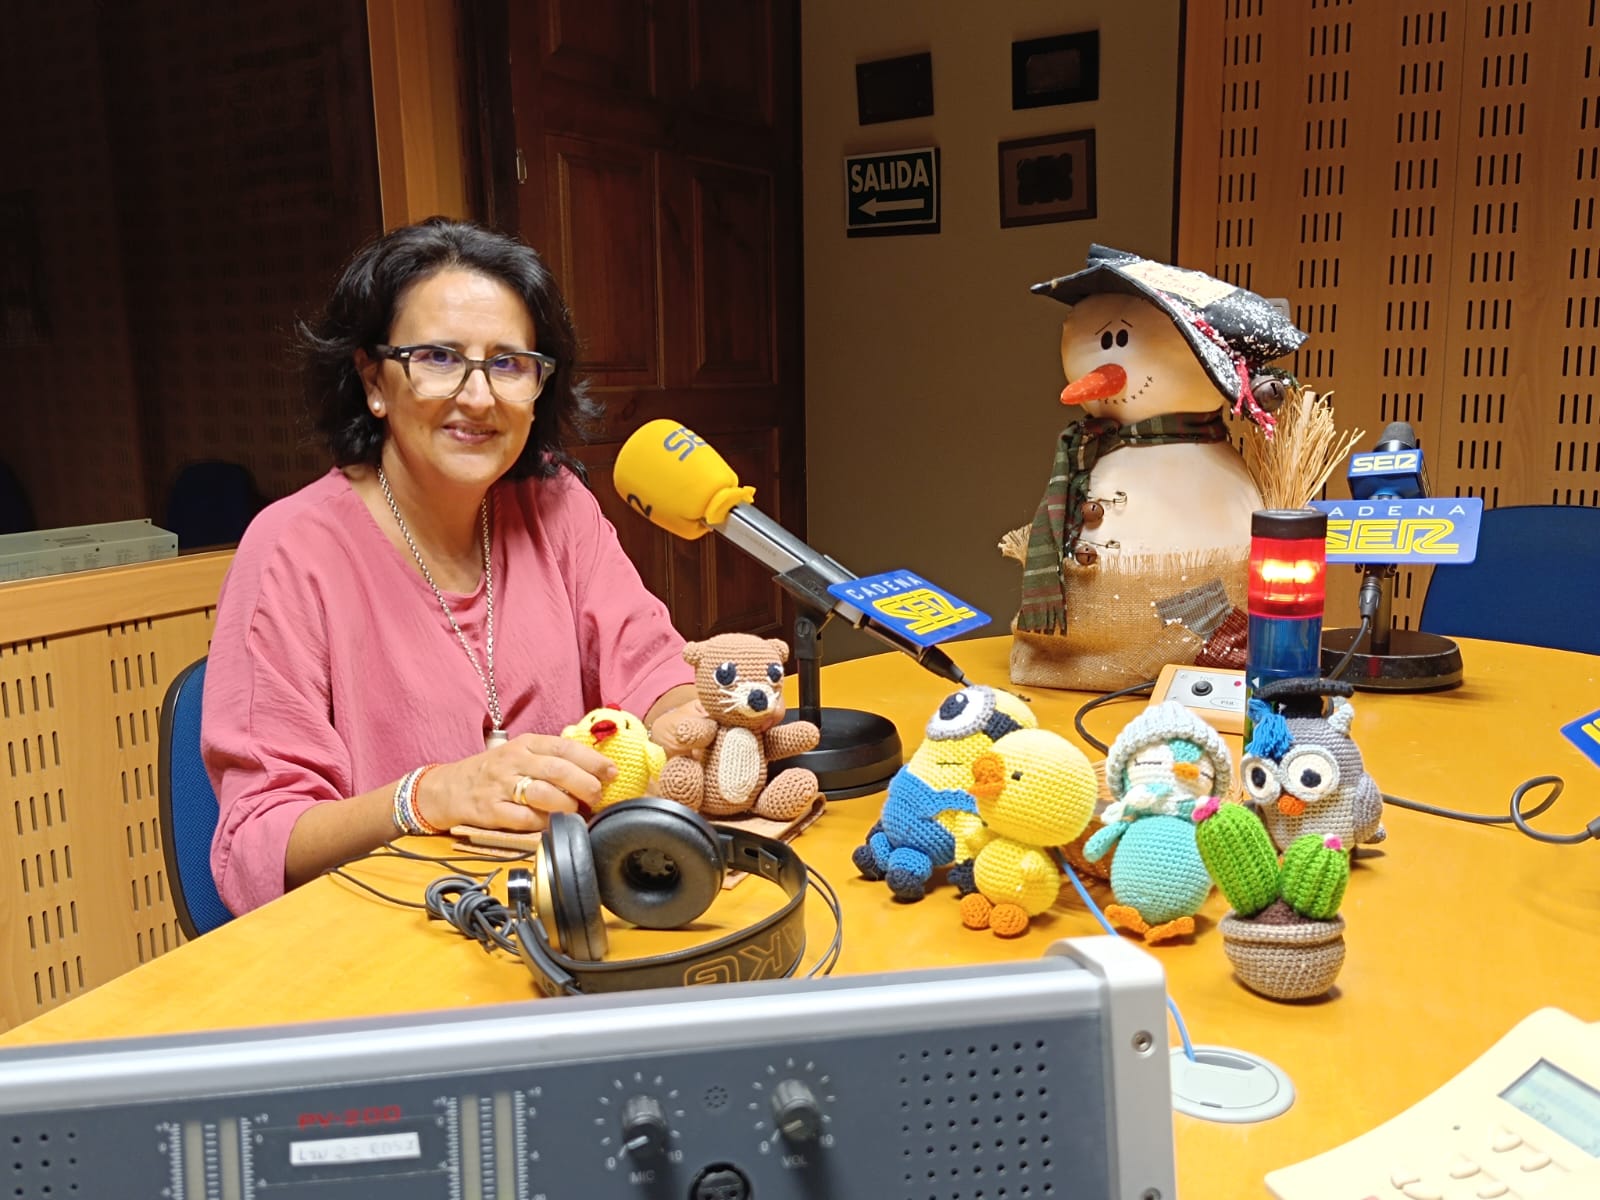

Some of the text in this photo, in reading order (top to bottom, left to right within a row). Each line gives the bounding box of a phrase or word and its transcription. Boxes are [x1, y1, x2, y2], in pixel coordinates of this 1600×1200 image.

[850, 158, 930, 193] SALIDA
[1351, 453, 1417, 473] SER
[1327, 504, 1466, 517] ADENA
[845, 575, 923, 601] CADENA
[871, 587, 978, 636] SER
[297, 1103, 402, 1131] PV-200
[781, 1154, 808, 1168] VOL
[631, 1169, 656, 1183] MIC
